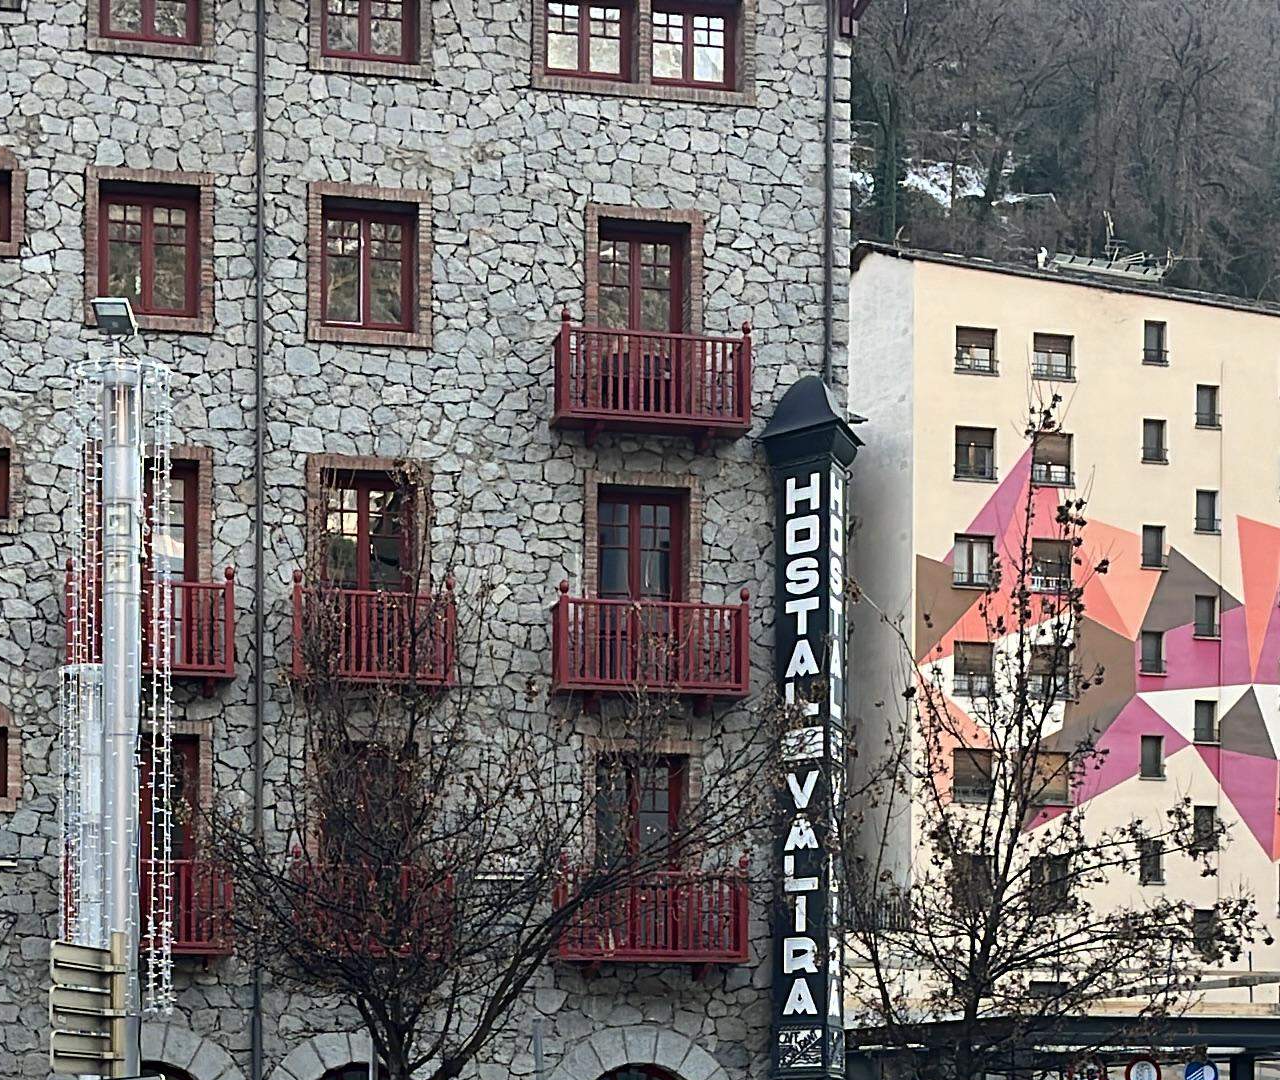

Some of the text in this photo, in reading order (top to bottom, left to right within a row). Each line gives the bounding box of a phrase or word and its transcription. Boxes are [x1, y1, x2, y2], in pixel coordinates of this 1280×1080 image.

[785, 472, 820, 717] HOSTAL
[829, 471, 843, 720] HOSTAL
[783, 770, 821, 1016] VALIRA
